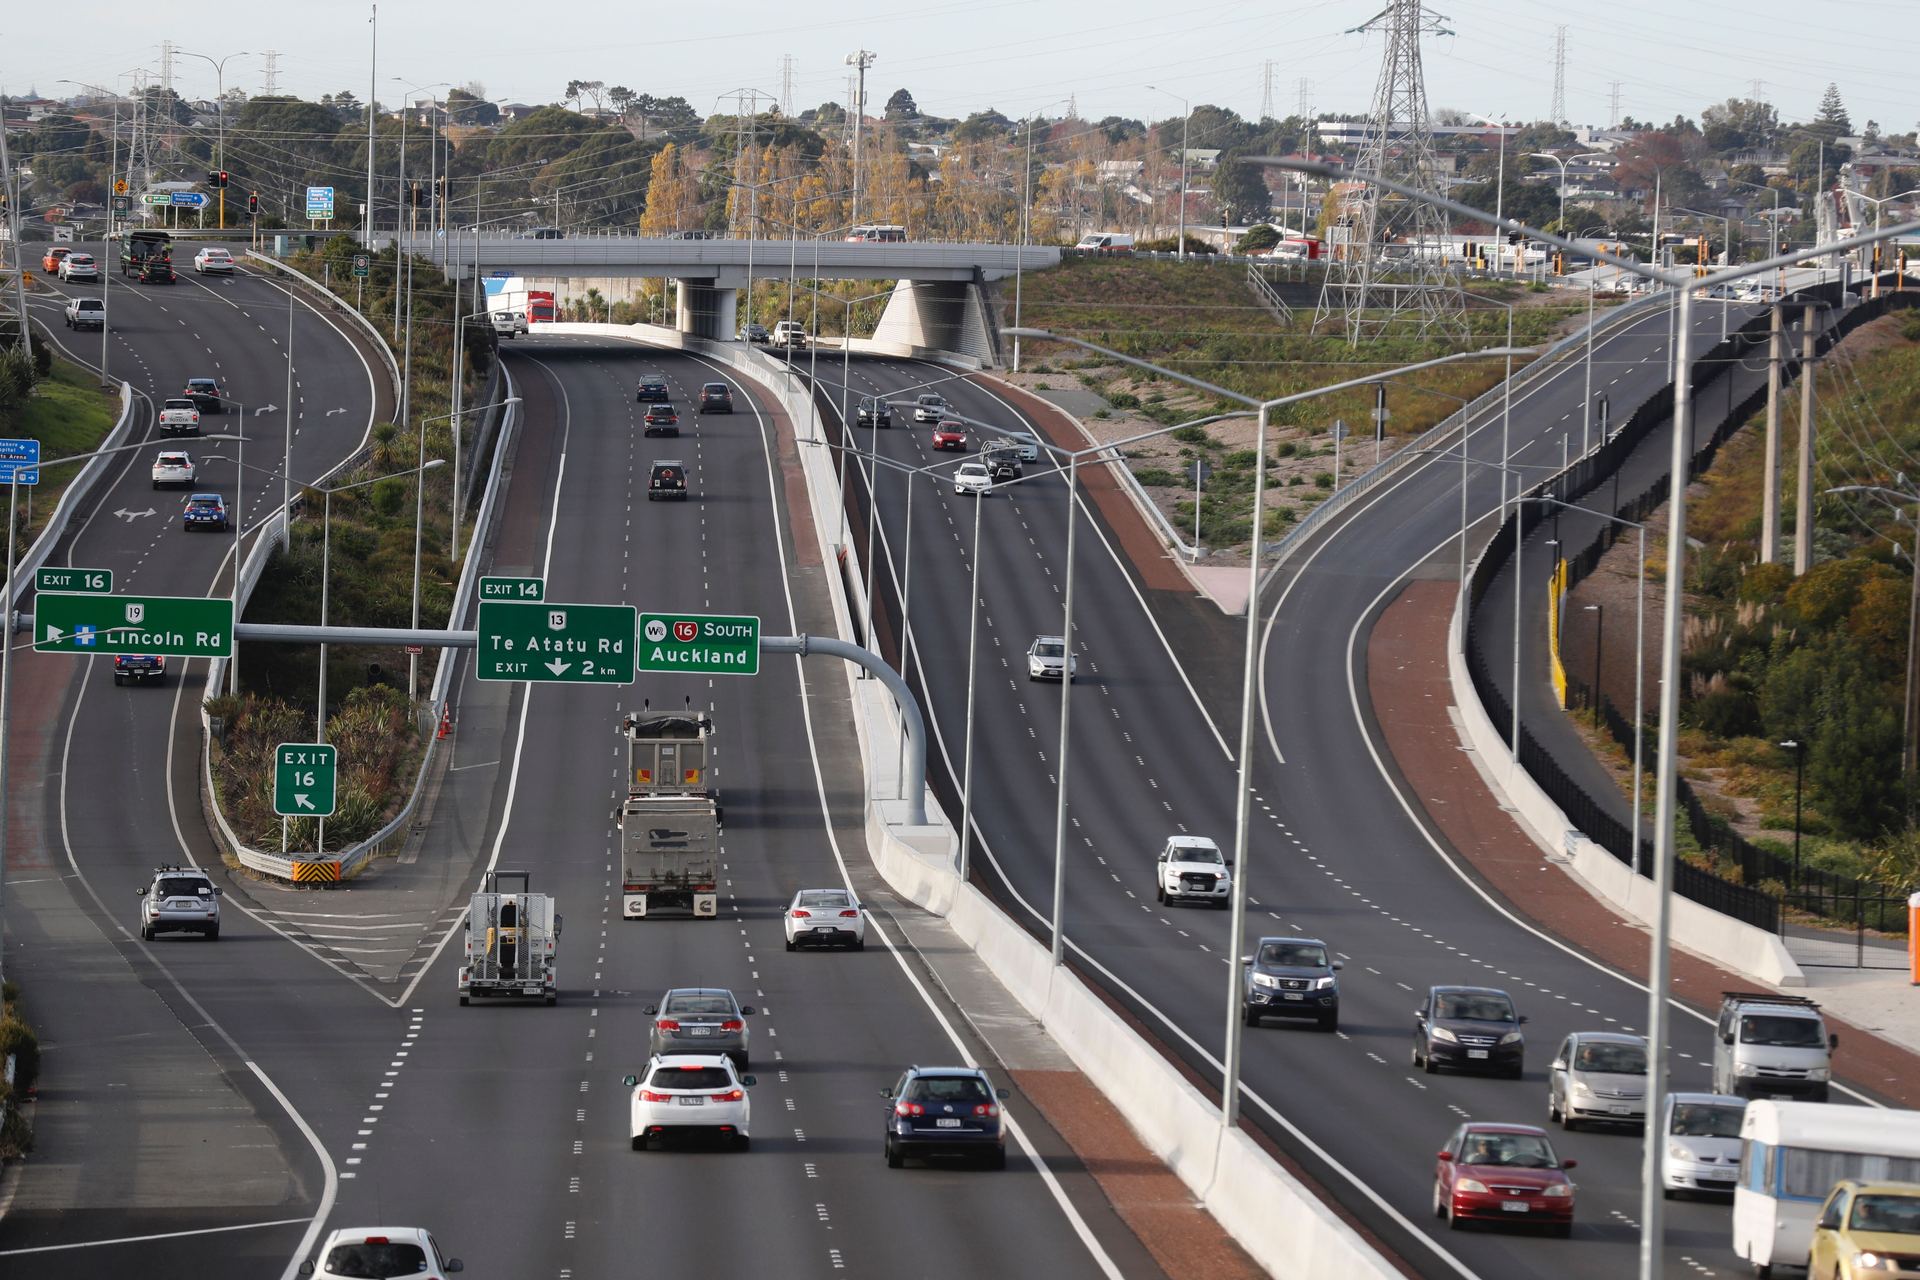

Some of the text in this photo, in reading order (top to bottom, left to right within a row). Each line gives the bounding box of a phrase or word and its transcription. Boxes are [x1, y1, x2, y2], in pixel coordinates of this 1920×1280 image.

[43, 574, 105, 589] EXIT 16
[485, 583, 538, 597] EXIT 14
[129, 607, 140, 618] 19
[551, 615, 564, 626] 13
[106, 629, 221, 648] Lincoln Rd
[678, 625, 693, 637] 16
[491, 635, 623, 654] Te Atatu Rd
[650, 647, 747, 665] Auckland
[495, 660, 616, 676] EXIT 2 km
[284, 752, 328, 765] EXIT
[294, 771, 315, 787] 16
